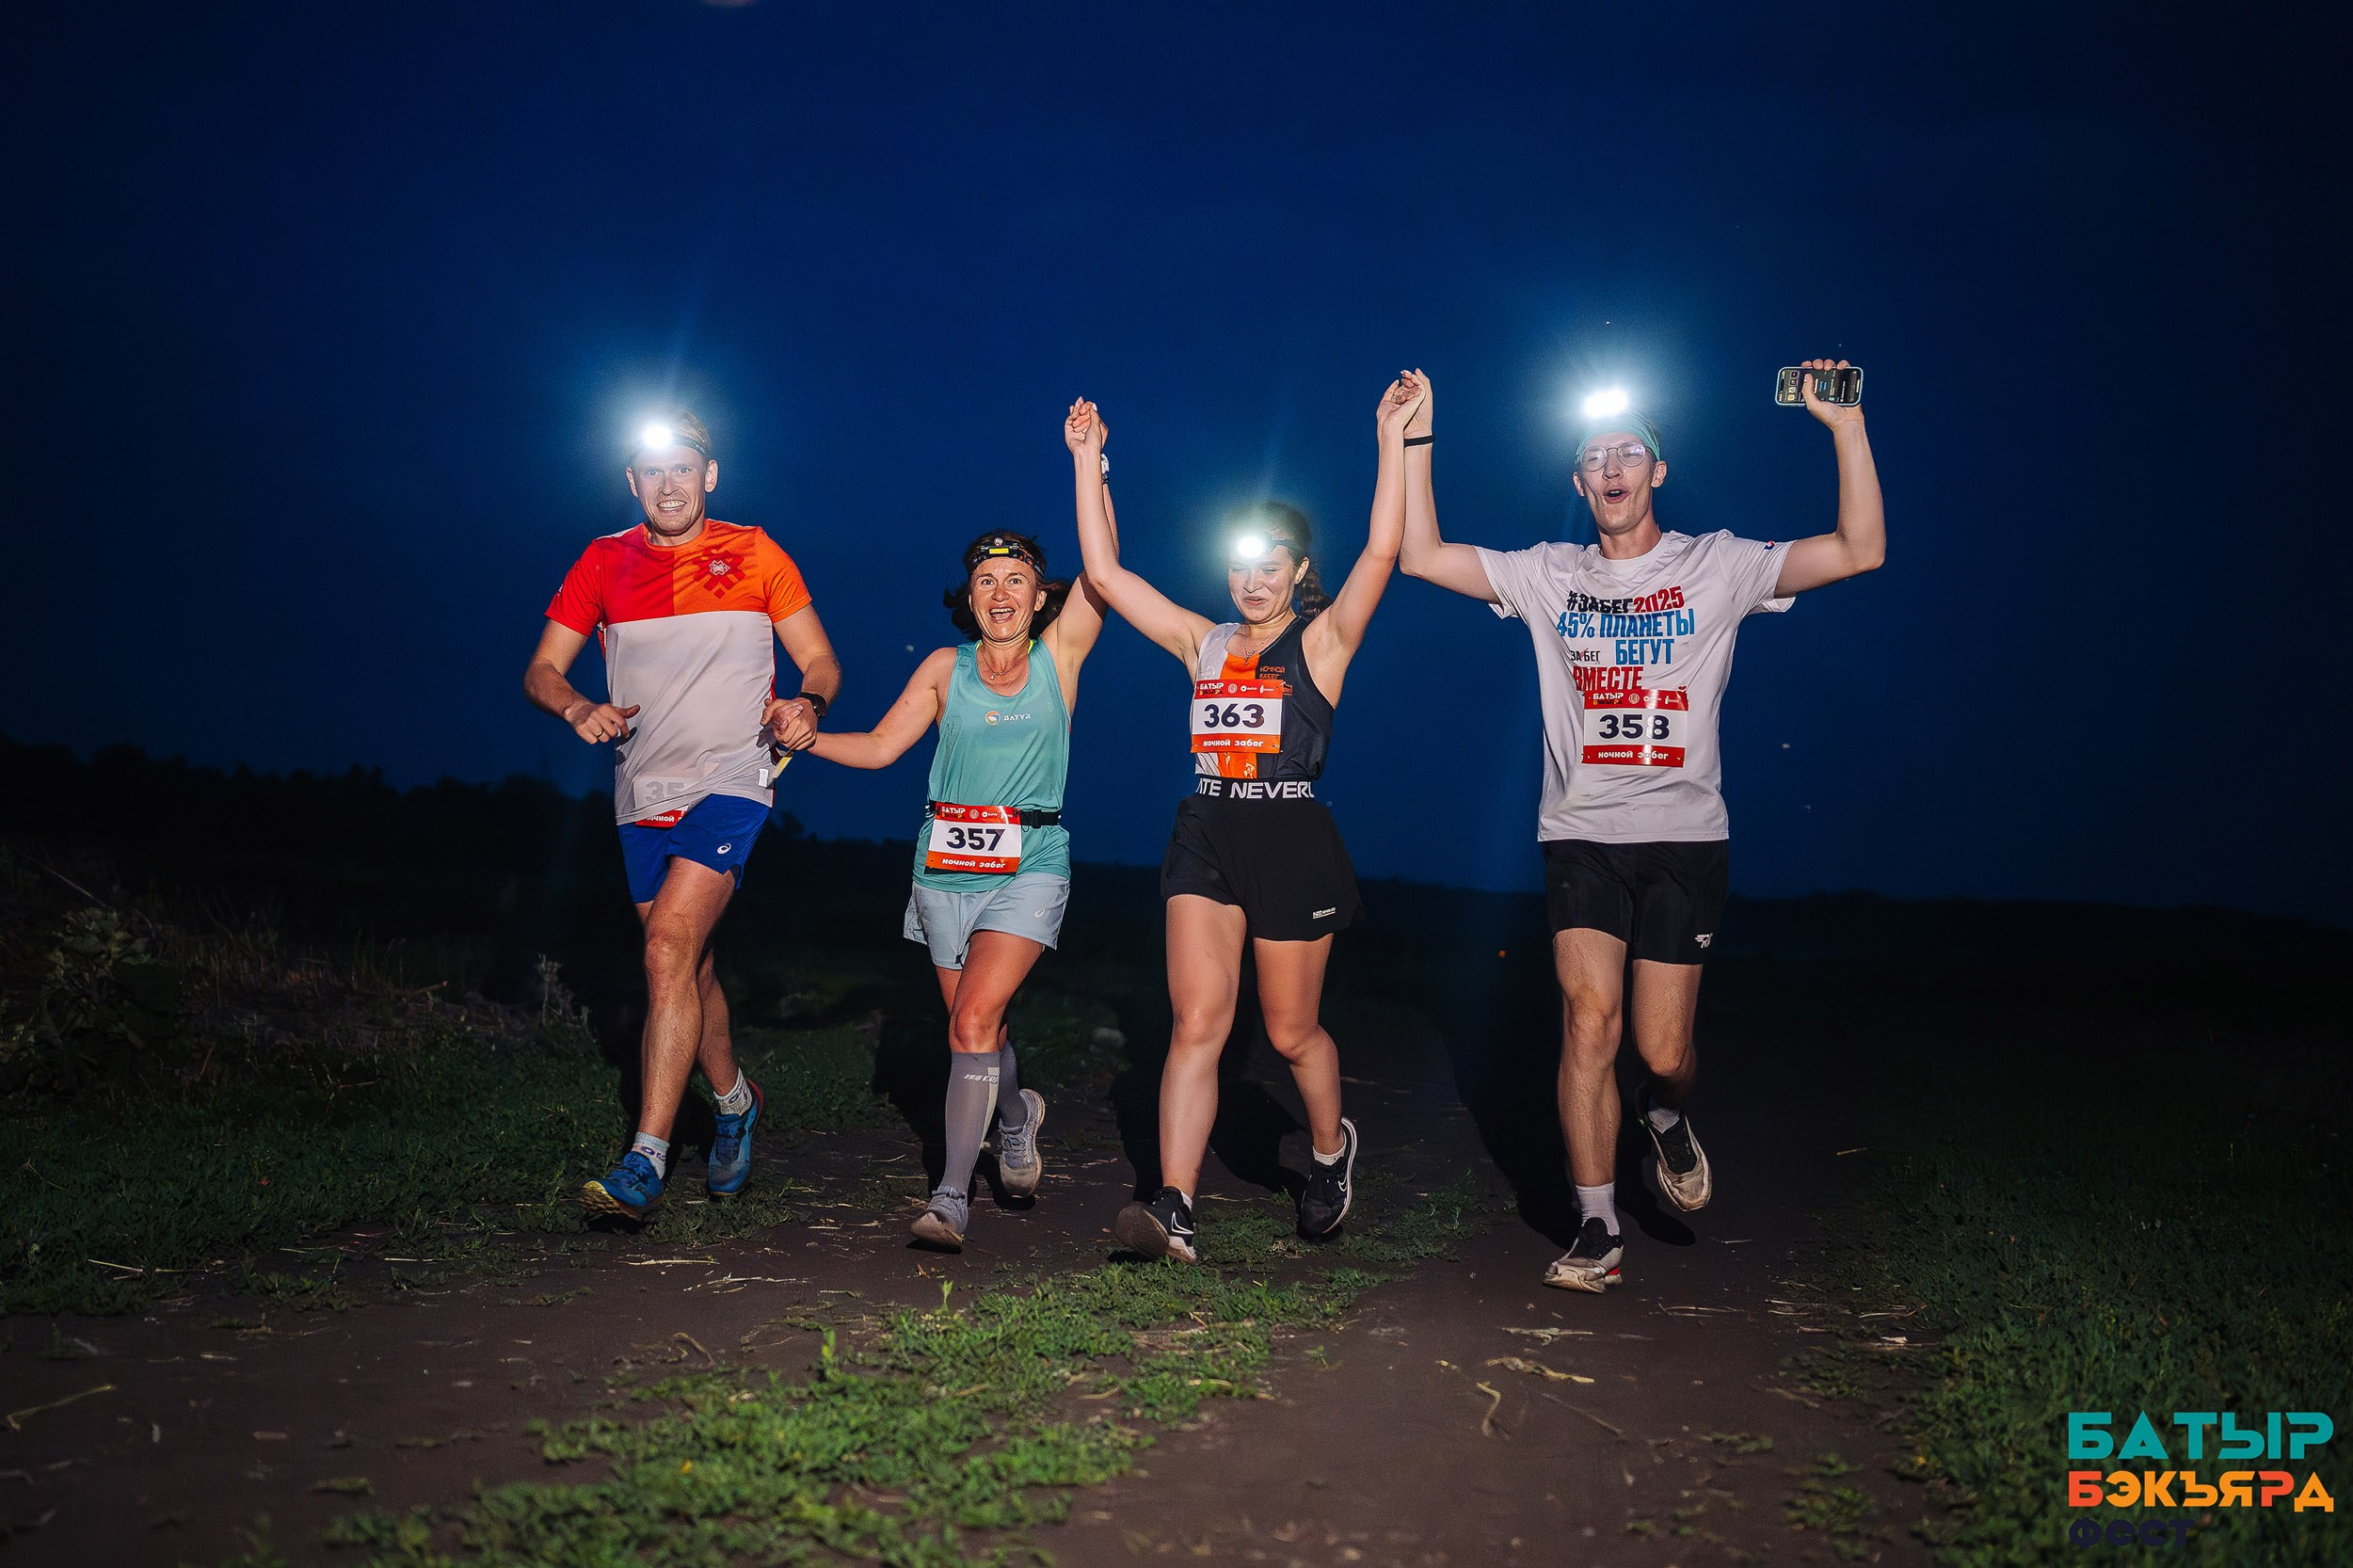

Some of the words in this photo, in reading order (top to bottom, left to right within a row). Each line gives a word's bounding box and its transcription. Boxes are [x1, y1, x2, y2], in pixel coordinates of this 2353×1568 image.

[1557, 612, 1595, 638] 45%
[1600, 608, 1695, 638] ПЛАНЕТЫ
[1615, 638, 1674, 664] БЕГУТ
[1572, 665, 1643, 691] ВМЕСТЕ
[1204, 703, 1264, 728] 363
[1598, 713, 1670, 740] 358
[941, 806, 966, 814] БАТЫР
[946, 826, 1005, 852] 357
